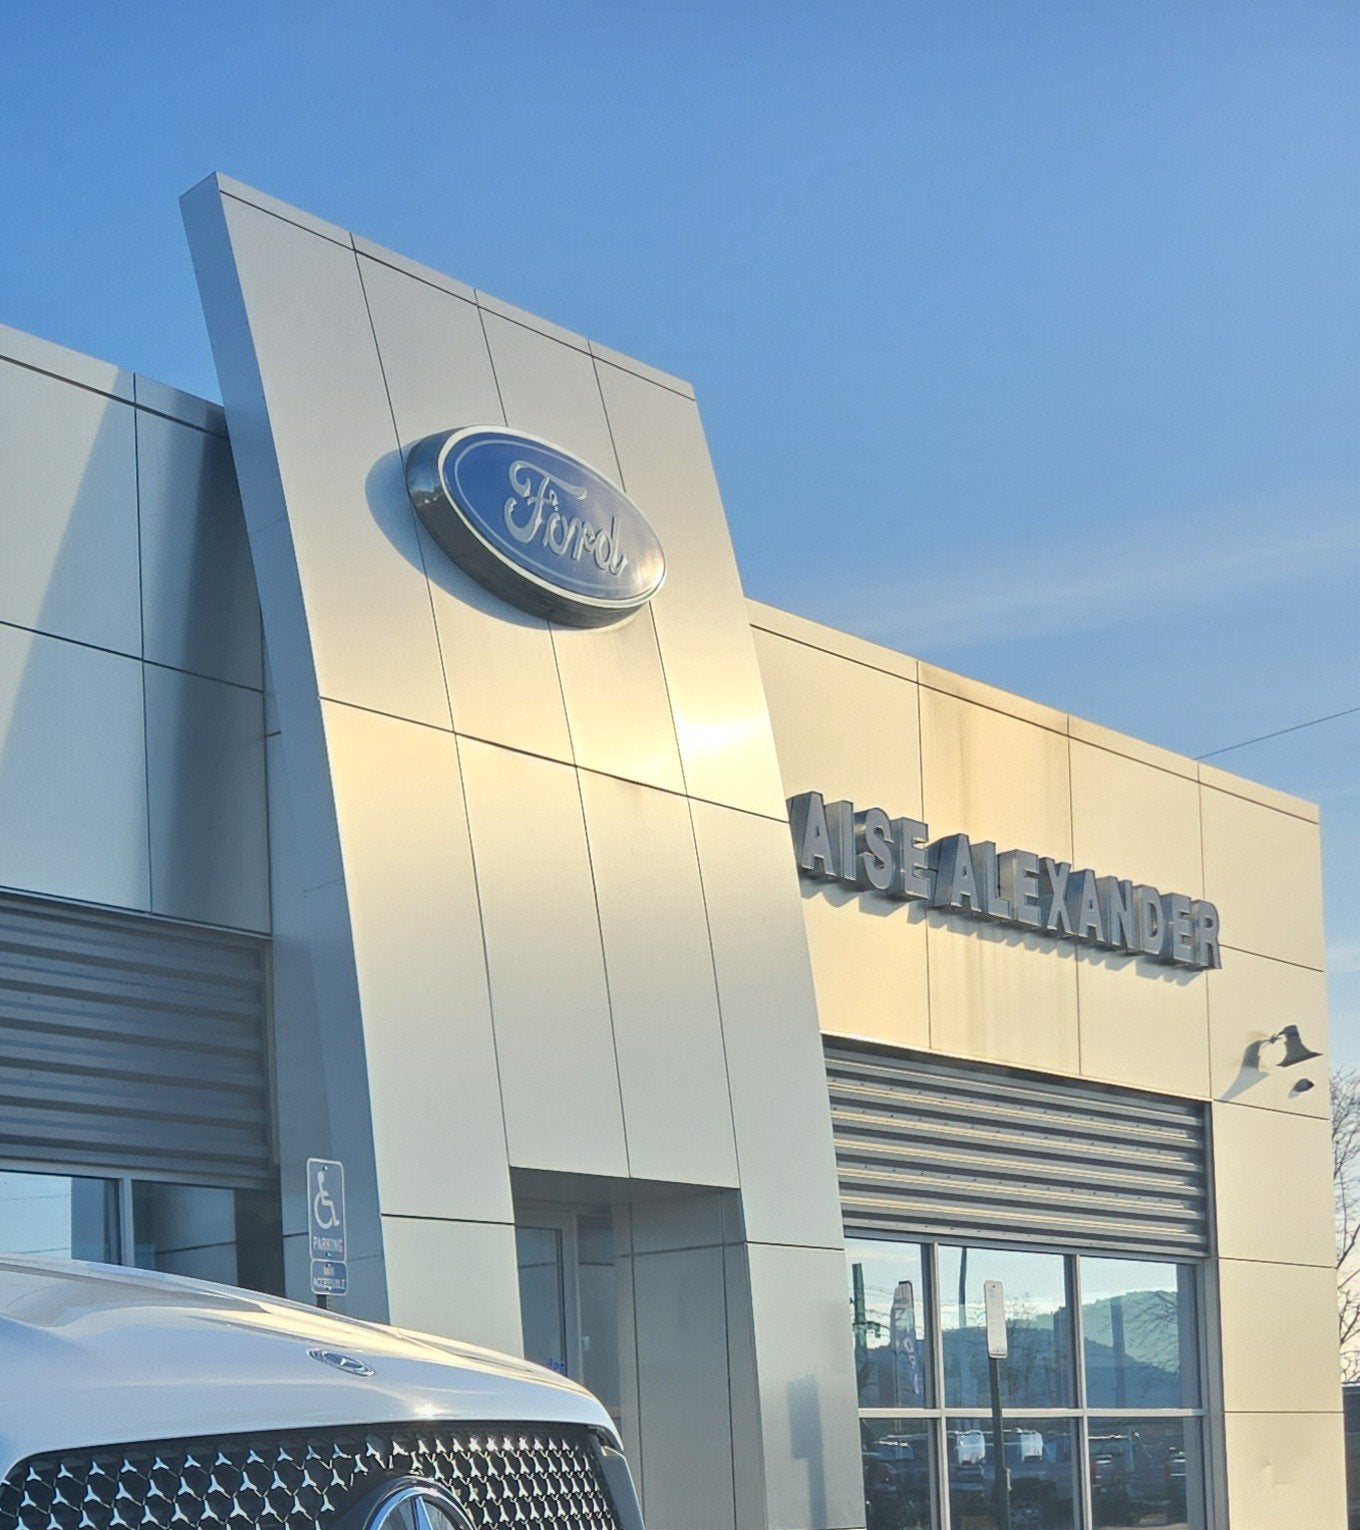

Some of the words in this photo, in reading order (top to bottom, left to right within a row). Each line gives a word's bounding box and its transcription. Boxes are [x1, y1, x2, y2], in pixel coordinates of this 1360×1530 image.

[504, 460, 628, 576] Ford
[790, 791, 929, 899] AISE
[933, 833, 1222, 969] ALEXANDER
[313, 1236, 343, 1252] PARKING
